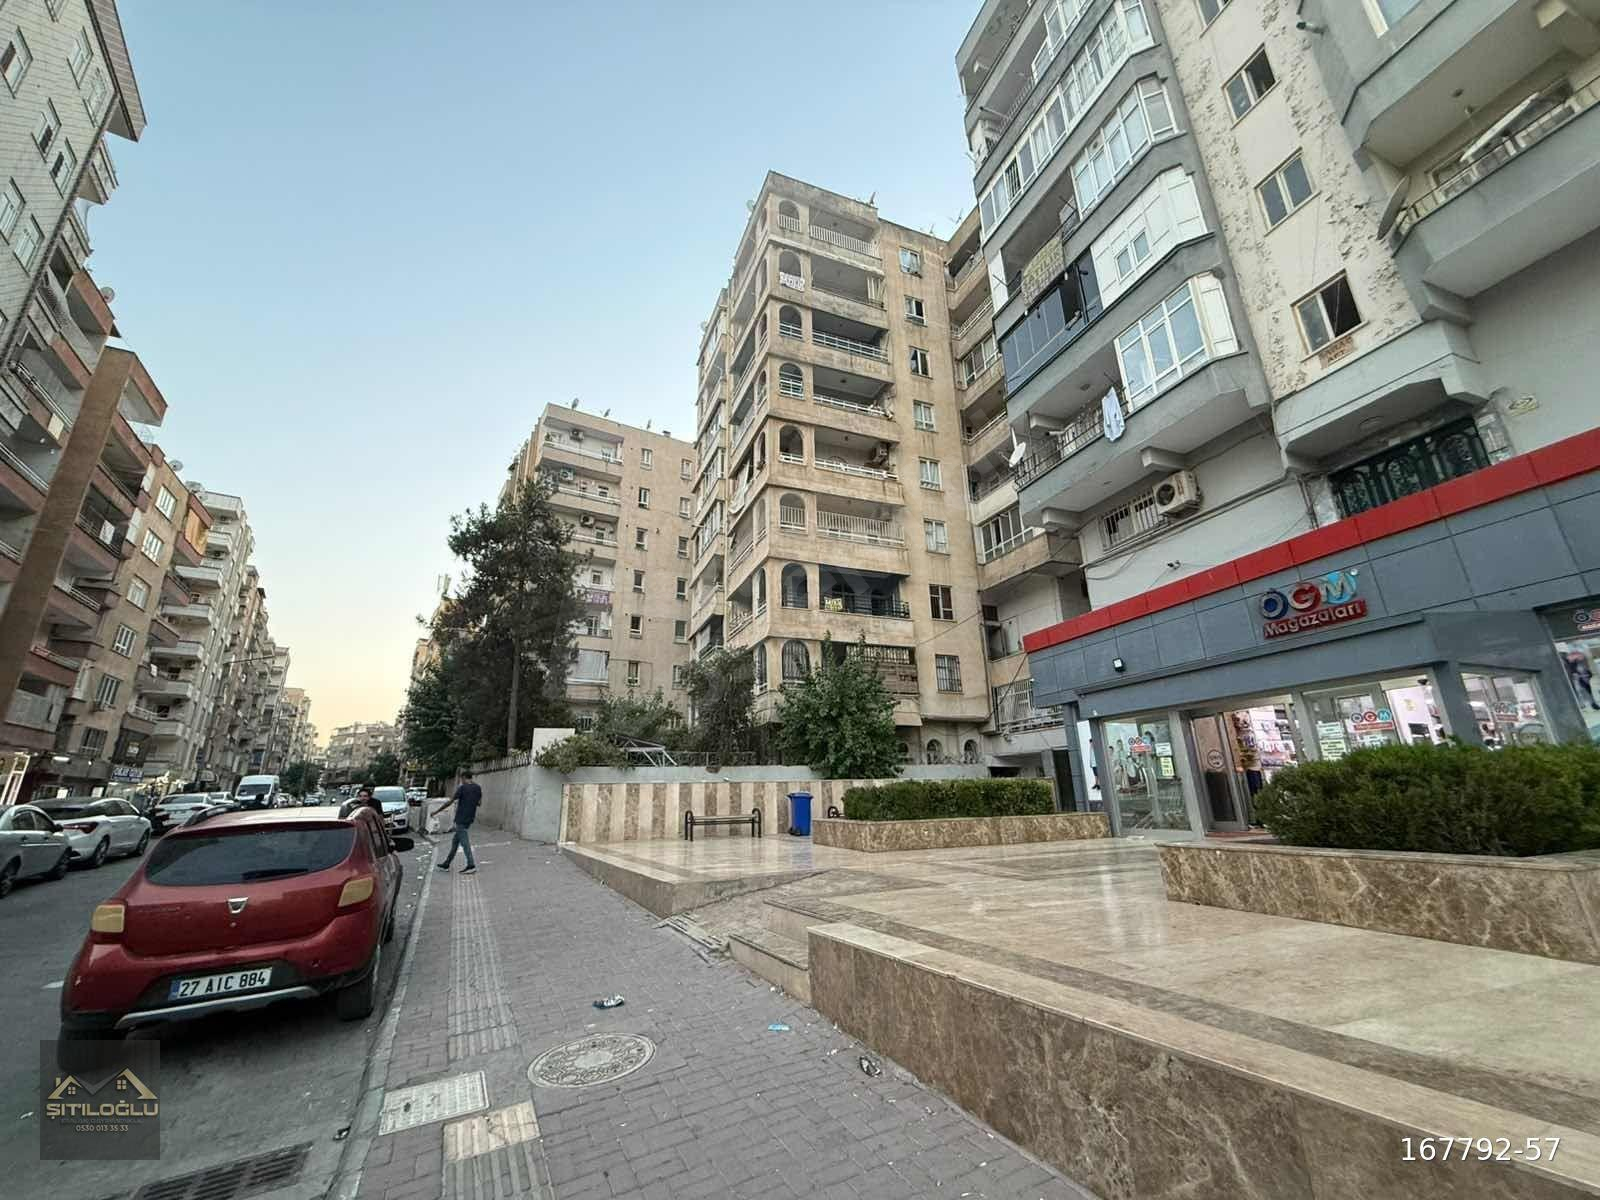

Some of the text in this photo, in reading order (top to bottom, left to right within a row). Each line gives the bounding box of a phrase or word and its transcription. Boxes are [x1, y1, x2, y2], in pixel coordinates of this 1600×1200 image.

[180, 971, 266, 997] 27 AIC 884
